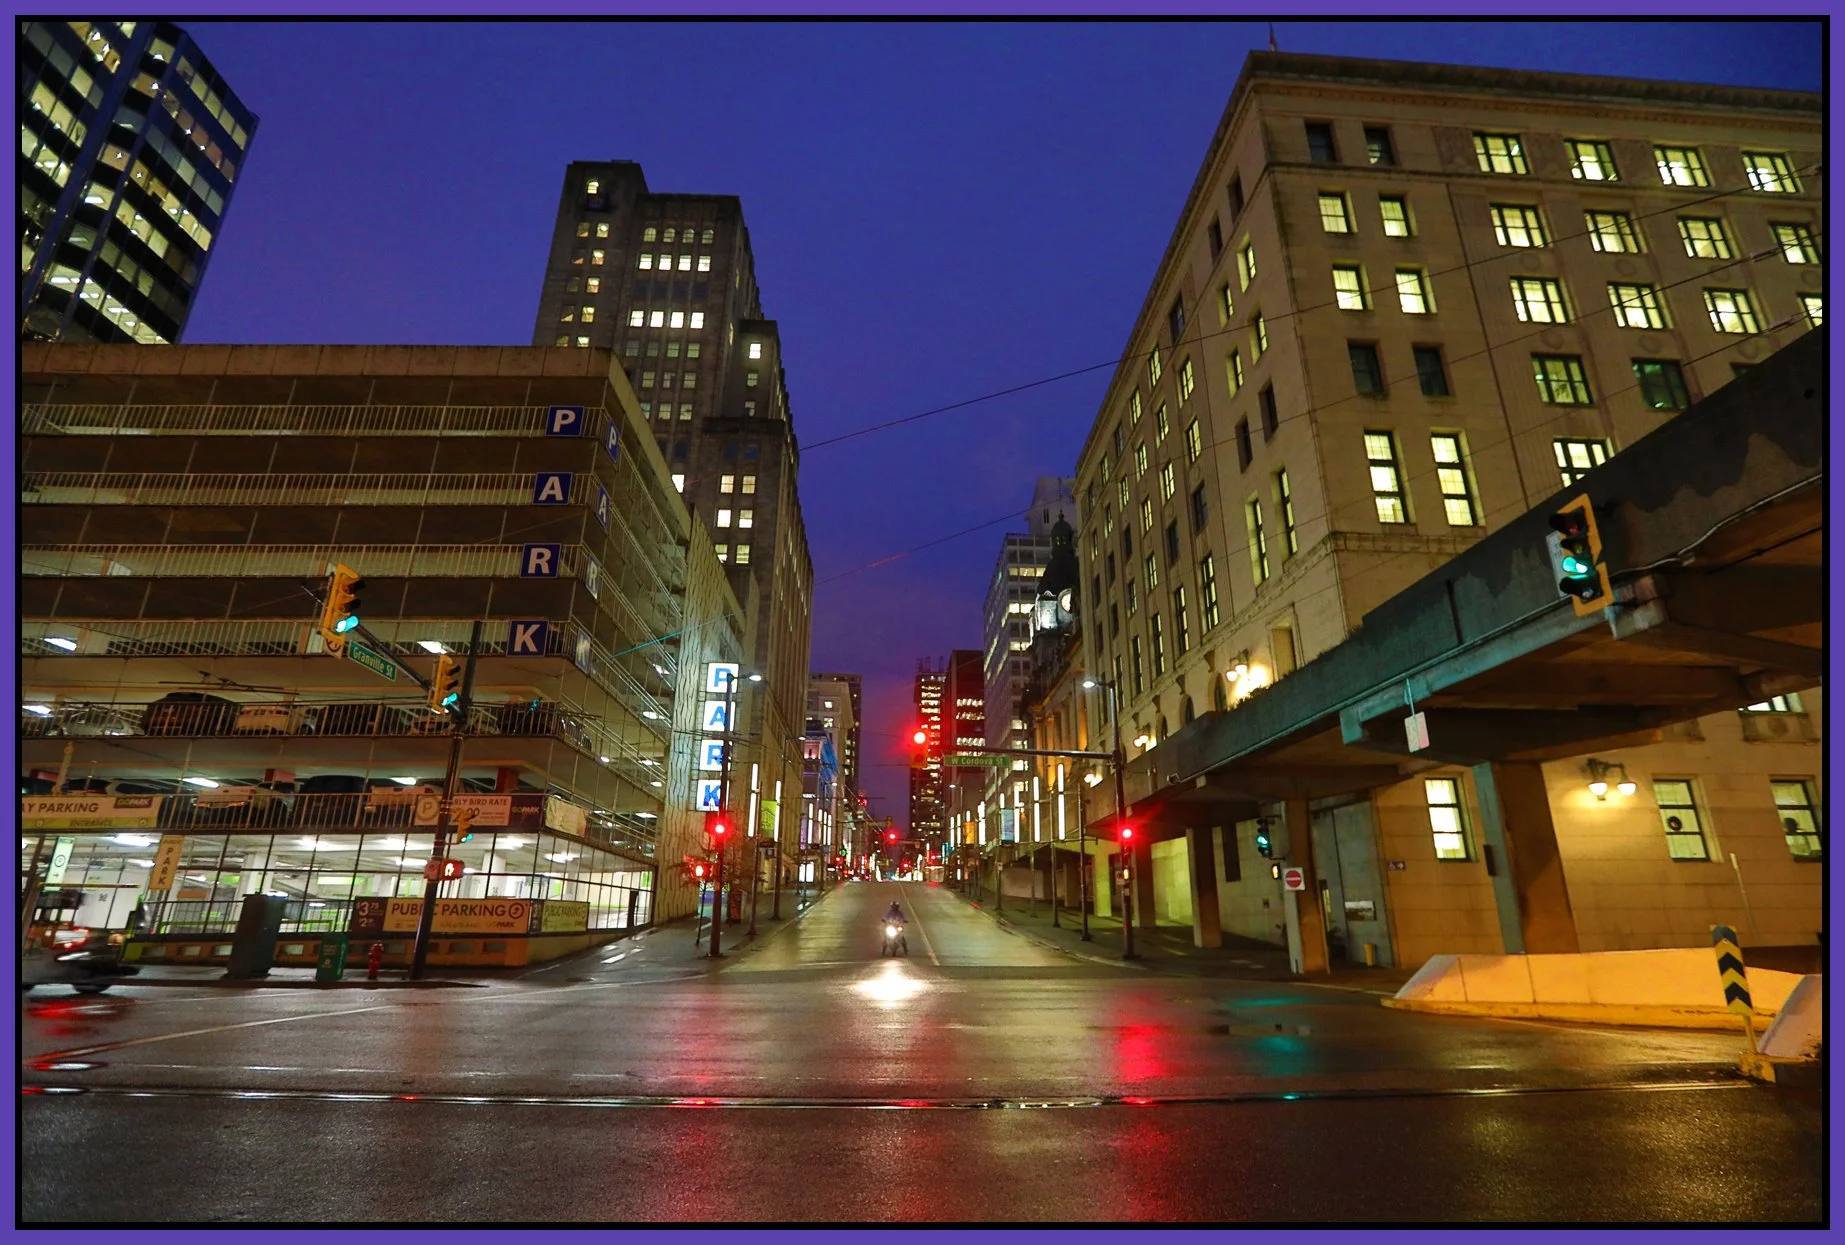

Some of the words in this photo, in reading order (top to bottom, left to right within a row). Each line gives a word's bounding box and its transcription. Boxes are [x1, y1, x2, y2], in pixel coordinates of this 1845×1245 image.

[552, 409, 577, 433] P
[608, 430, 618, 449] P
[538, 476, 564, 501] A
[598, 494, 608, 522] A
[527, 547, 551, 575] R
[588, 566, 598, 594] R
[514, 624, 541, 652] K
[352, 646, 385, 673] Granville
[386, 664, 393, 677] St
[703, 667, 732, 807] PARK
[38, 802, 99, 813] PARKING
[469, 798, 488, 806] BIRD
[489, 798, 507, 806] RATE
[158, 847, 174, 885] PARK
[441, 903, 507, 917] PARKING
